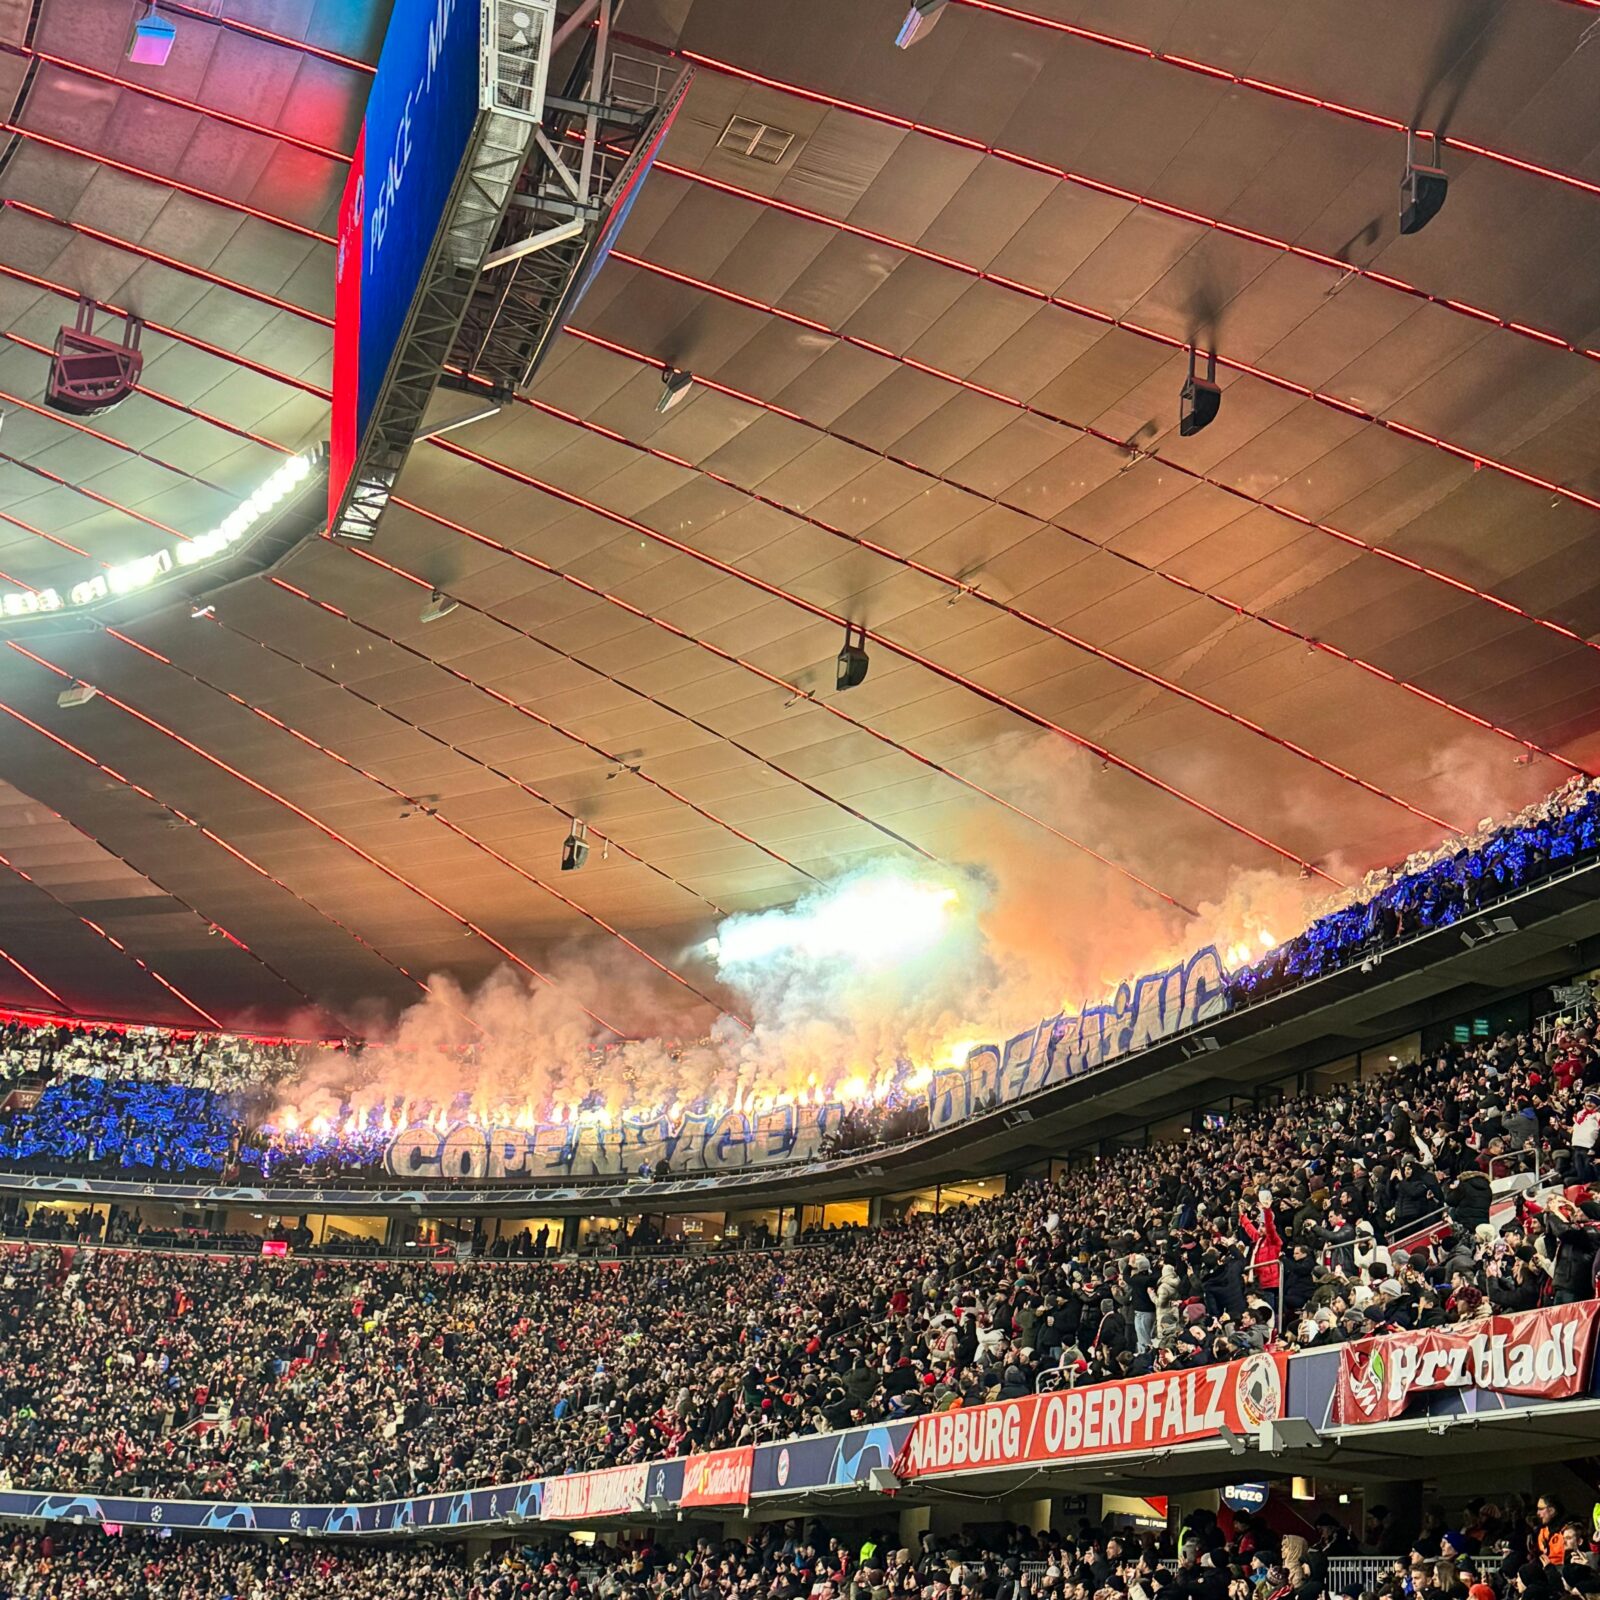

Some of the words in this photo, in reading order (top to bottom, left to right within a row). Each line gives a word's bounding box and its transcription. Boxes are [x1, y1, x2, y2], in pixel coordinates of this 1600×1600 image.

[369, 90, 413, 275] PEACE
[384, 1102, 843, 1178] COPENHAGEN
[909, 1403, 1020, 1470] NABBURG
[1044, 1365, 1229, 1453] OBERPFALZ
[1224, 1485, 1264, 1503] Breze
